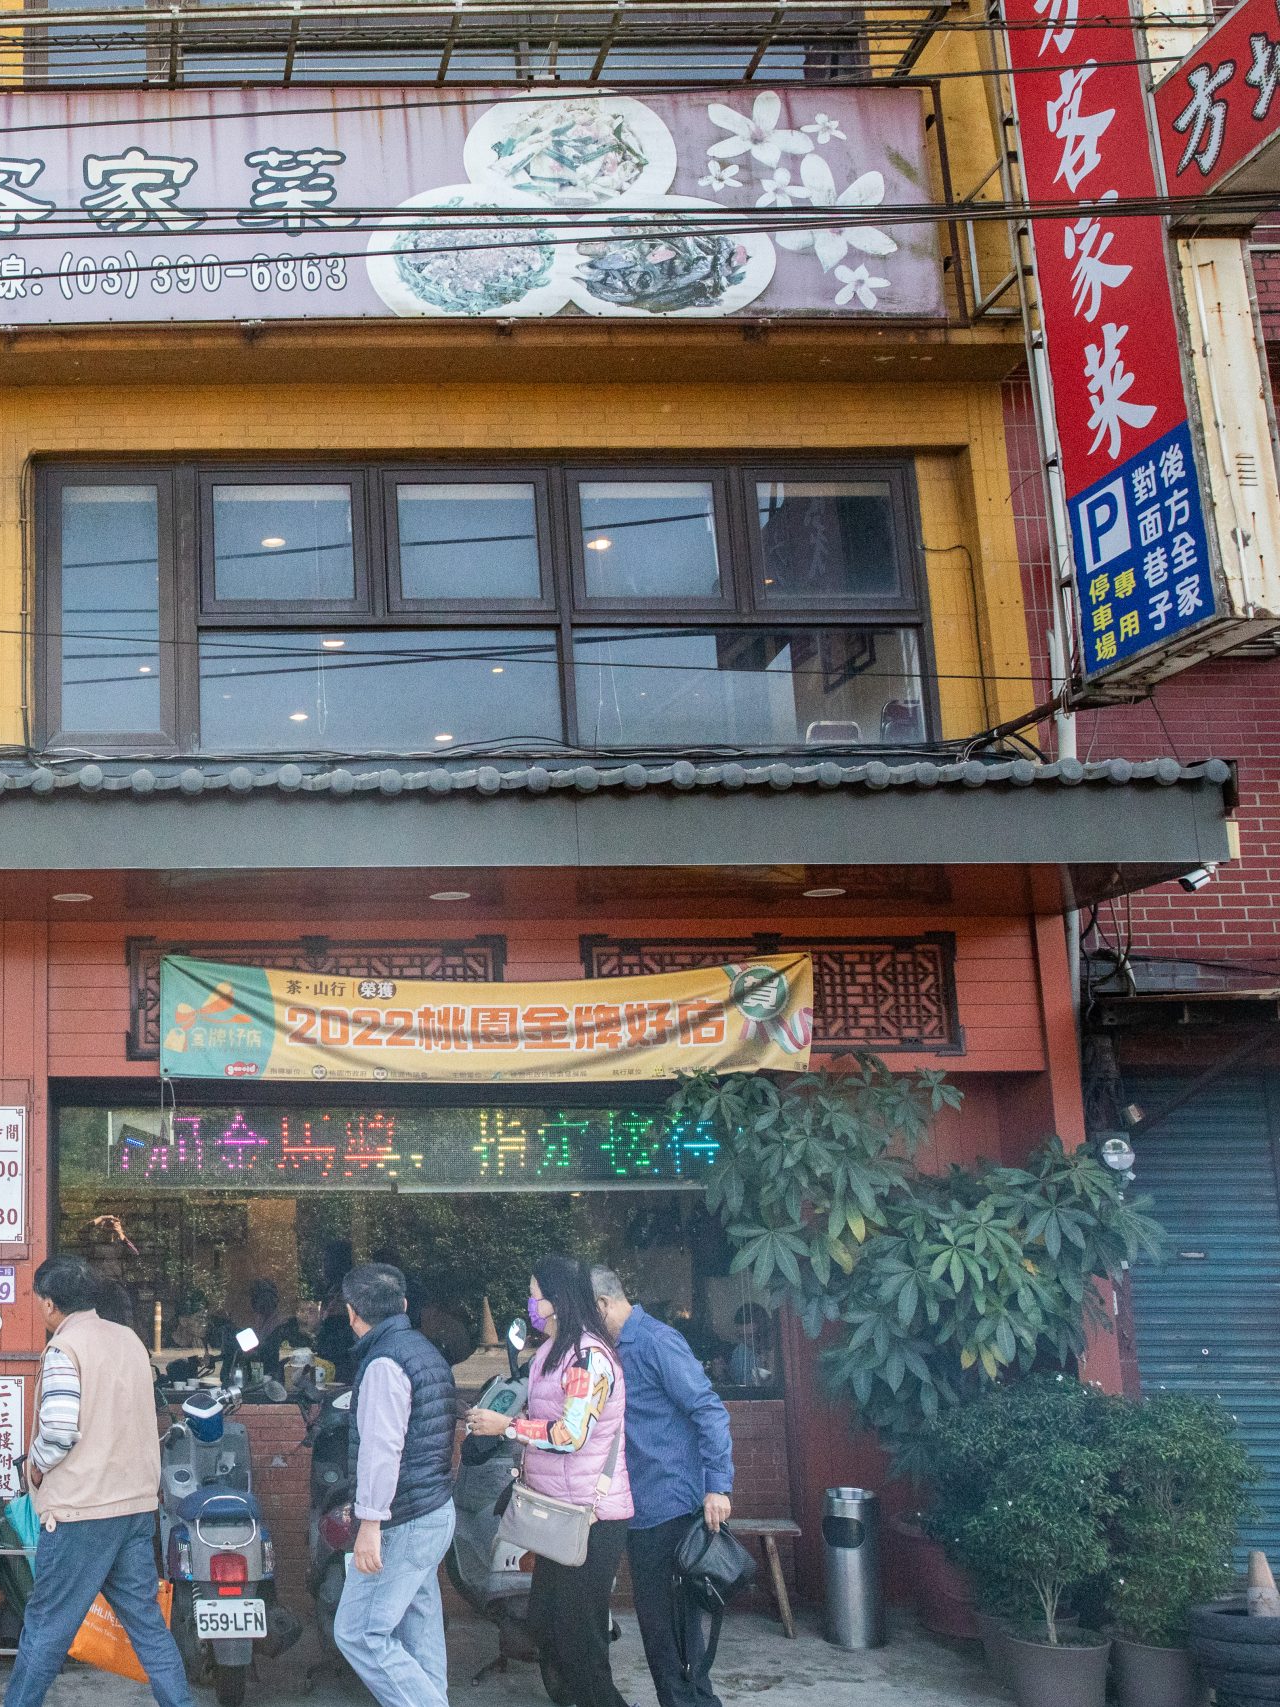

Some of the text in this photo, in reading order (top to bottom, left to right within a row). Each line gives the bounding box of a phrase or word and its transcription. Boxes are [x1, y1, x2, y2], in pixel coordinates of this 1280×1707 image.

[150, 250, 348, 293] 390-6863
[1086, 491, 1119, 571] P
[1131, 460, 1172, 631] 對面巷子
[1159, 443, 1203, 618] 後方全家
[1088, 573, 1117, 662] 停車場
[1113, 567, 1141, 642] 專用
[285, 998, 728, 1053] 2022桃園金牌好店
[360, 981, 394, 998] 榮獲
